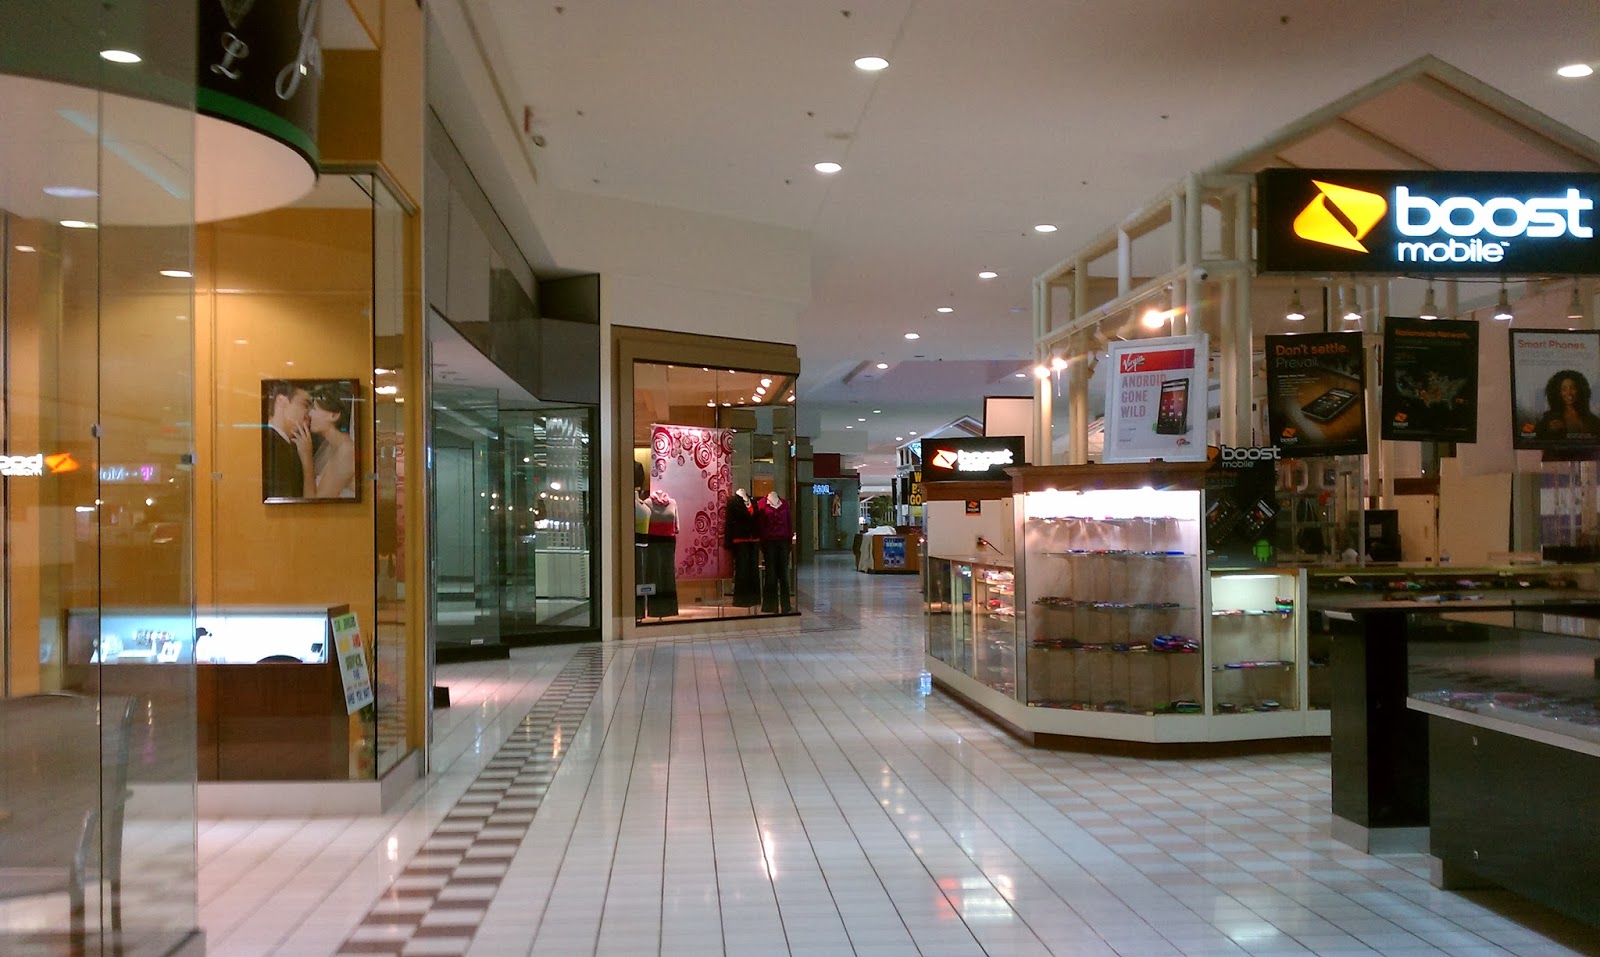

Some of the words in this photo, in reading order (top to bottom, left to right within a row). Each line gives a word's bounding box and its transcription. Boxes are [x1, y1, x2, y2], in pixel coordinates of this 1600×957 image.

[1396, 185, 1594, 239] boost
[1398, 238, 1505, 263] mobile
[1275, 344, 1308, 356] Don't
[1518, 340, 1547, 349] Smart
[1122, 352, 1145, 372] Virgin
[1121, 374, 1167, 389] ANDROID
[1121, 390, 1148, 403] GONE
[1120, 405, 1146, 418] WILD
[1221, 445, 1281, 461] boost
[1222, 461, 1255, 469] mobile
